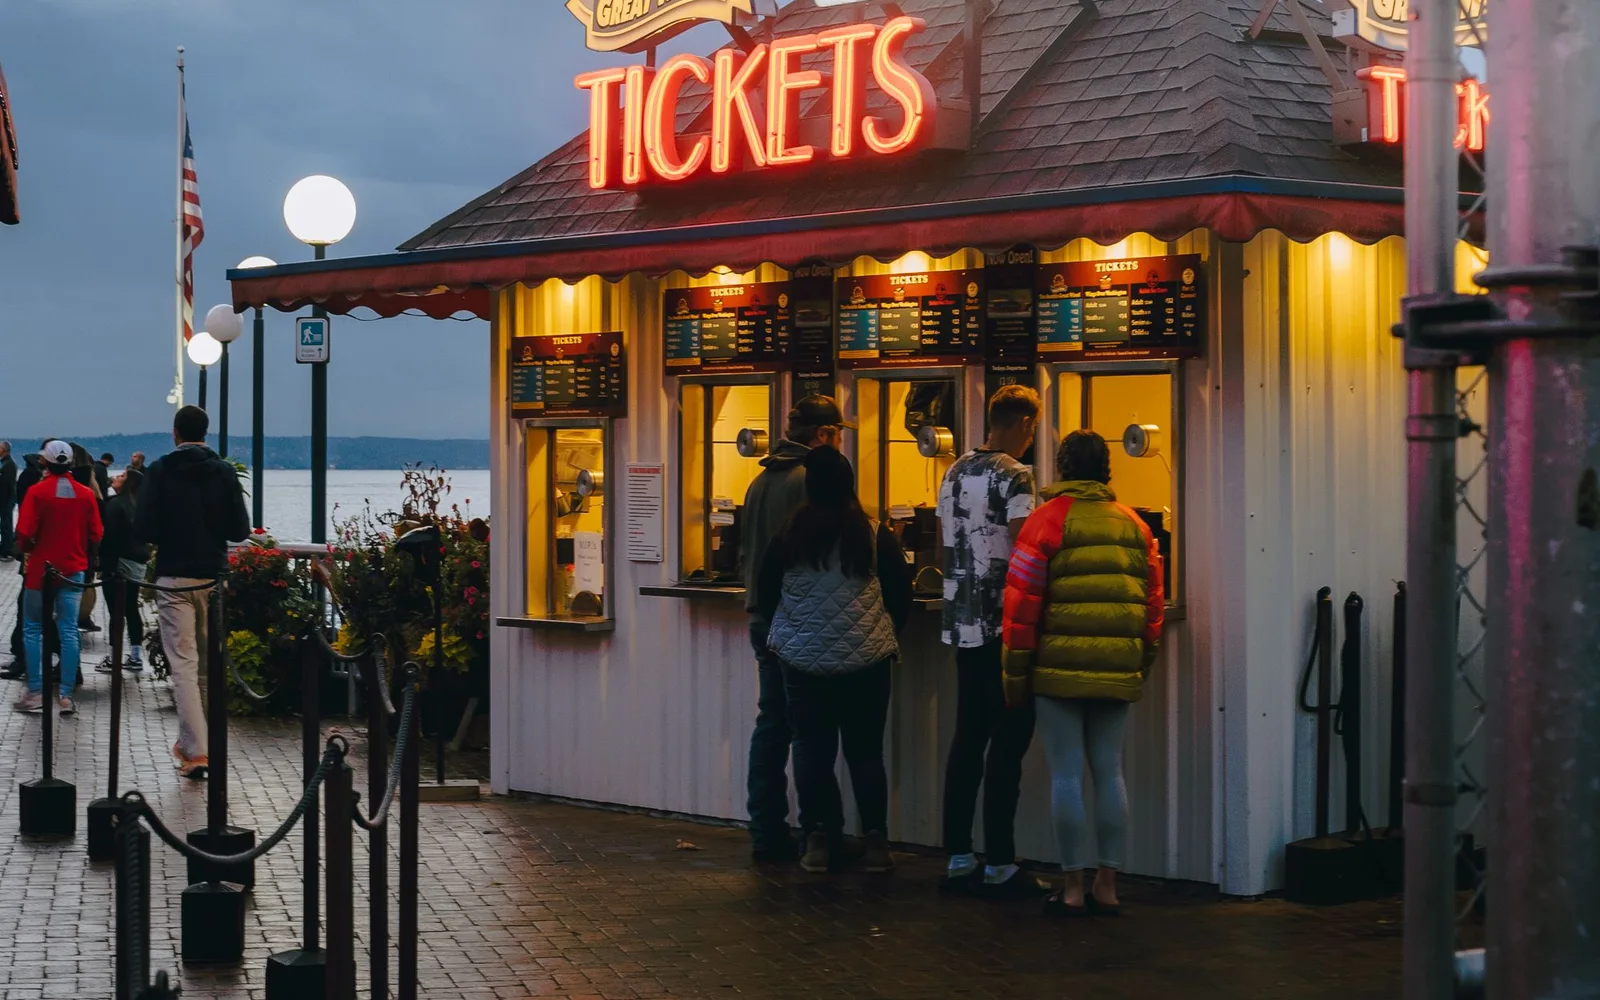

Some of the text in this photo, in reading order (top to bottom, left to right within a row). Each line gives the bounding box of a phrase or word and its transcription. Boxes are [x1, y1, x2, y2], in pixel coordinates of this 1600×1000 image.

[574, 16, 928, 189] TICKETS
[1095, 261, 1138, 272] TICKETS
[890, 274, 928, 285] TICKETS
[710, 287, 744, 296] TICKETS
[552, 336, 582, 345] TICKETS
